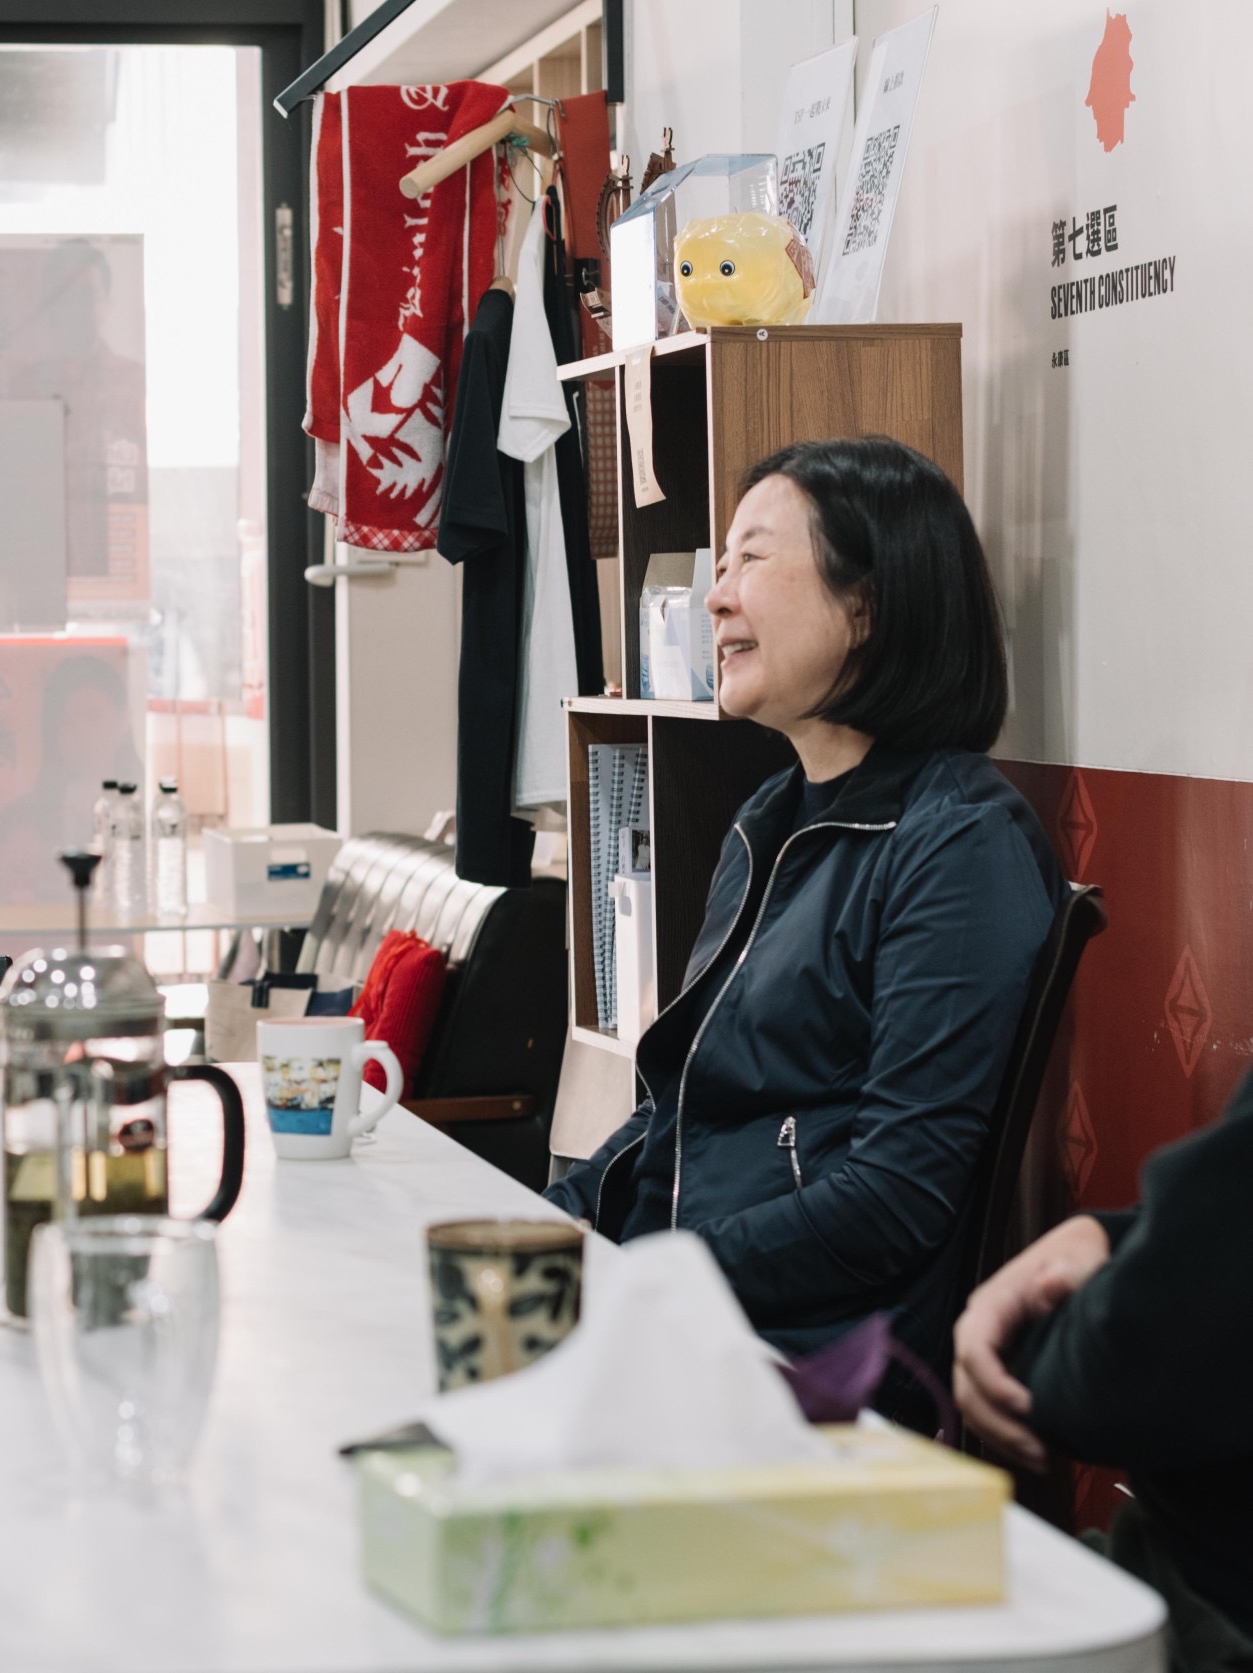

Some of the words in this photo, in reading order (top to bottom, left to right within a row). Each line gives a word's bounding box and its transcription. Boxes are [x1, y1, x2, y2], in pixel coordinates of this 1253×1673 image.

[1051, 204, 1119, 268] 第七選區
[1050, 276, 1096, 320] SEVENTH
[1097, 255, 1177, 309] CONSTITUENCY
[1051, 349, 1070, 369] 永康區
